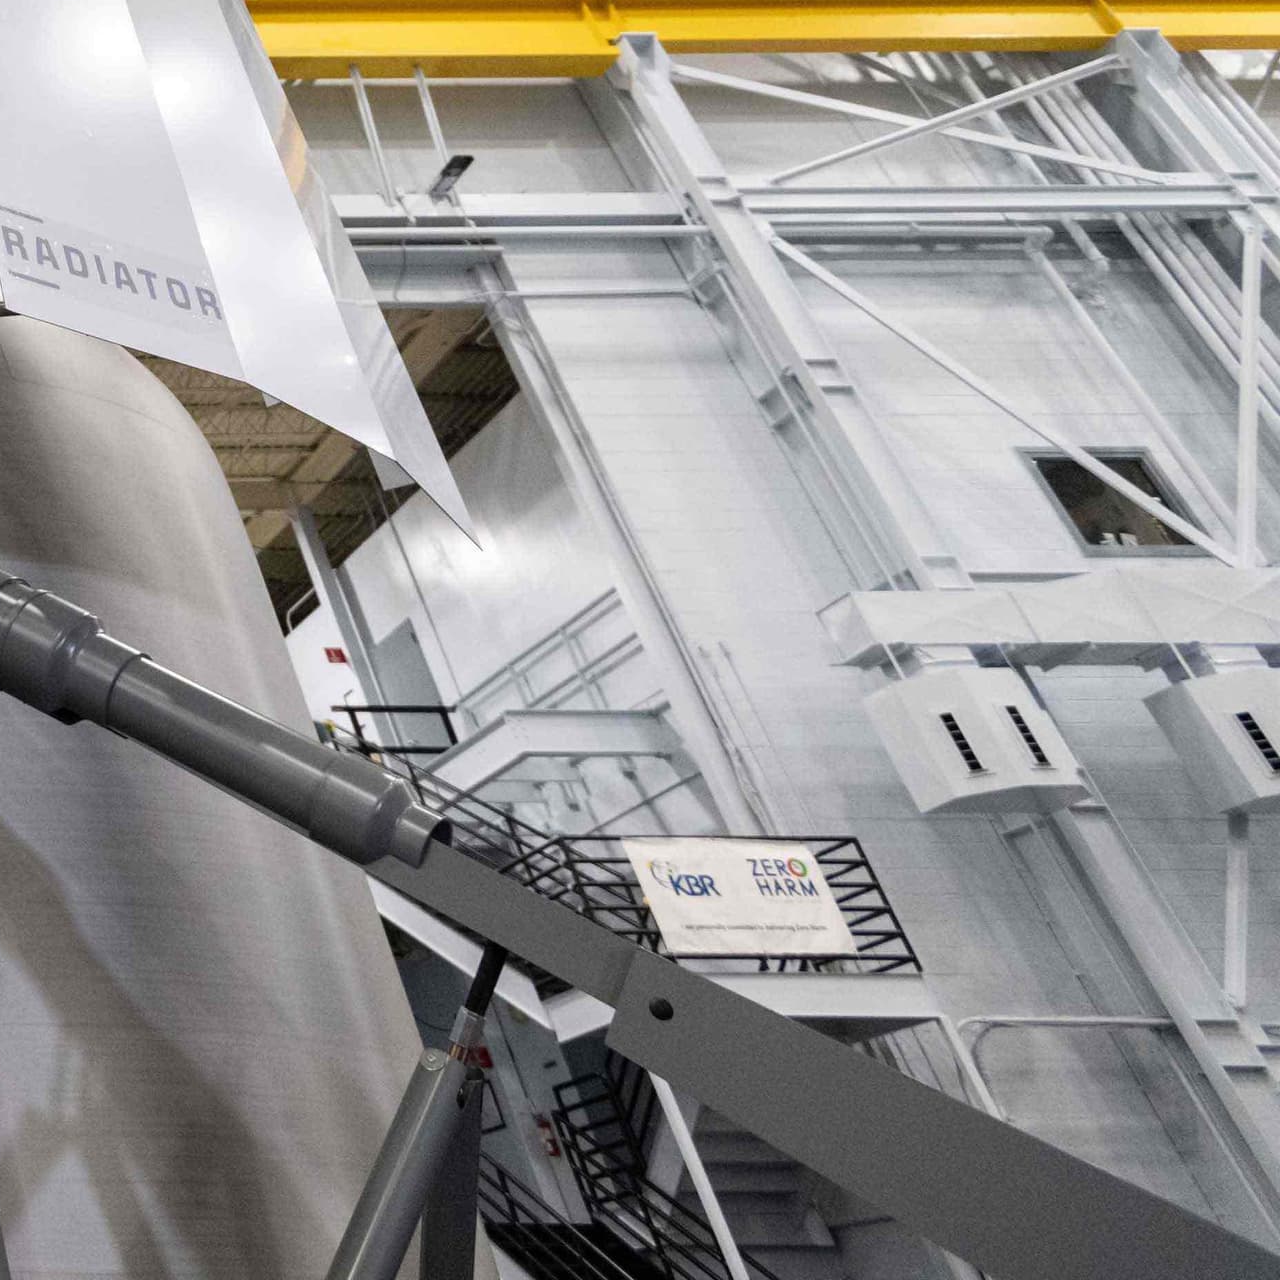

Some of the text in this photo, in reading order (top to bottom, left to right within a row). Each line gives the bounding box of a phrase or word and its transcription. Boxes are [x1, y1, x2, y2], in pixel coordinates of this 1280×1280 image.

[1, 225, 223, 321] RADIATOR
[746, 857, 809, 878] ZERO
[668, 874, 722, 897] KBR
[755, 879, 820, 897] HARM
